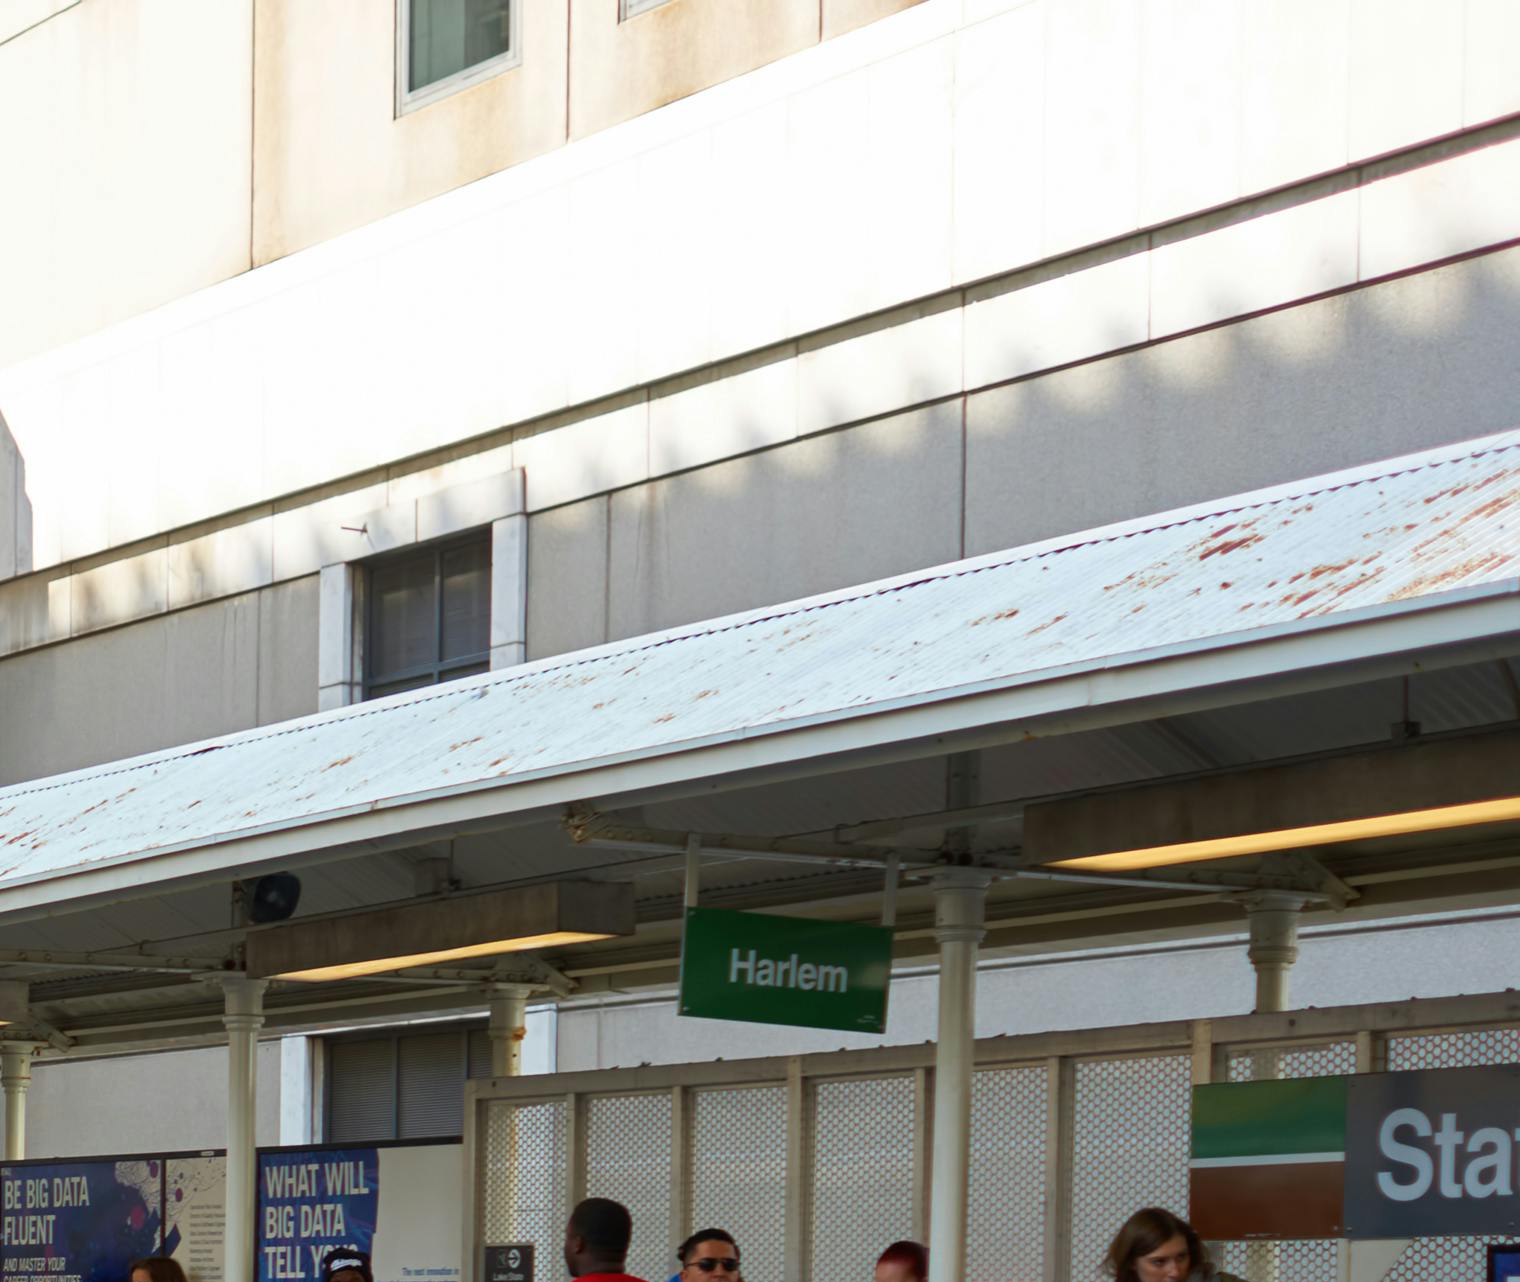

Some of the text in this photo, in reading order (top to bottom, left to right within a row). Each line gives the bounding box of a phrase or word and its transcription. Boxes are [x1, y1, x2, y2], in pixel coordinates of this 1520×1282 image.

[728, 947, 848, 994] Harlem
[1376, 1106, 1520, 1202] Sta
[3, 1175, 90, 1210] BE BIG DATA
[265, 1160, 370, 1200] WHAT WILL
[3, 1214, 57, 1246] FLUENT
[265, 1203, 347, 1240] BIG DATA
[263, 1245, 306, 1280] TELL
